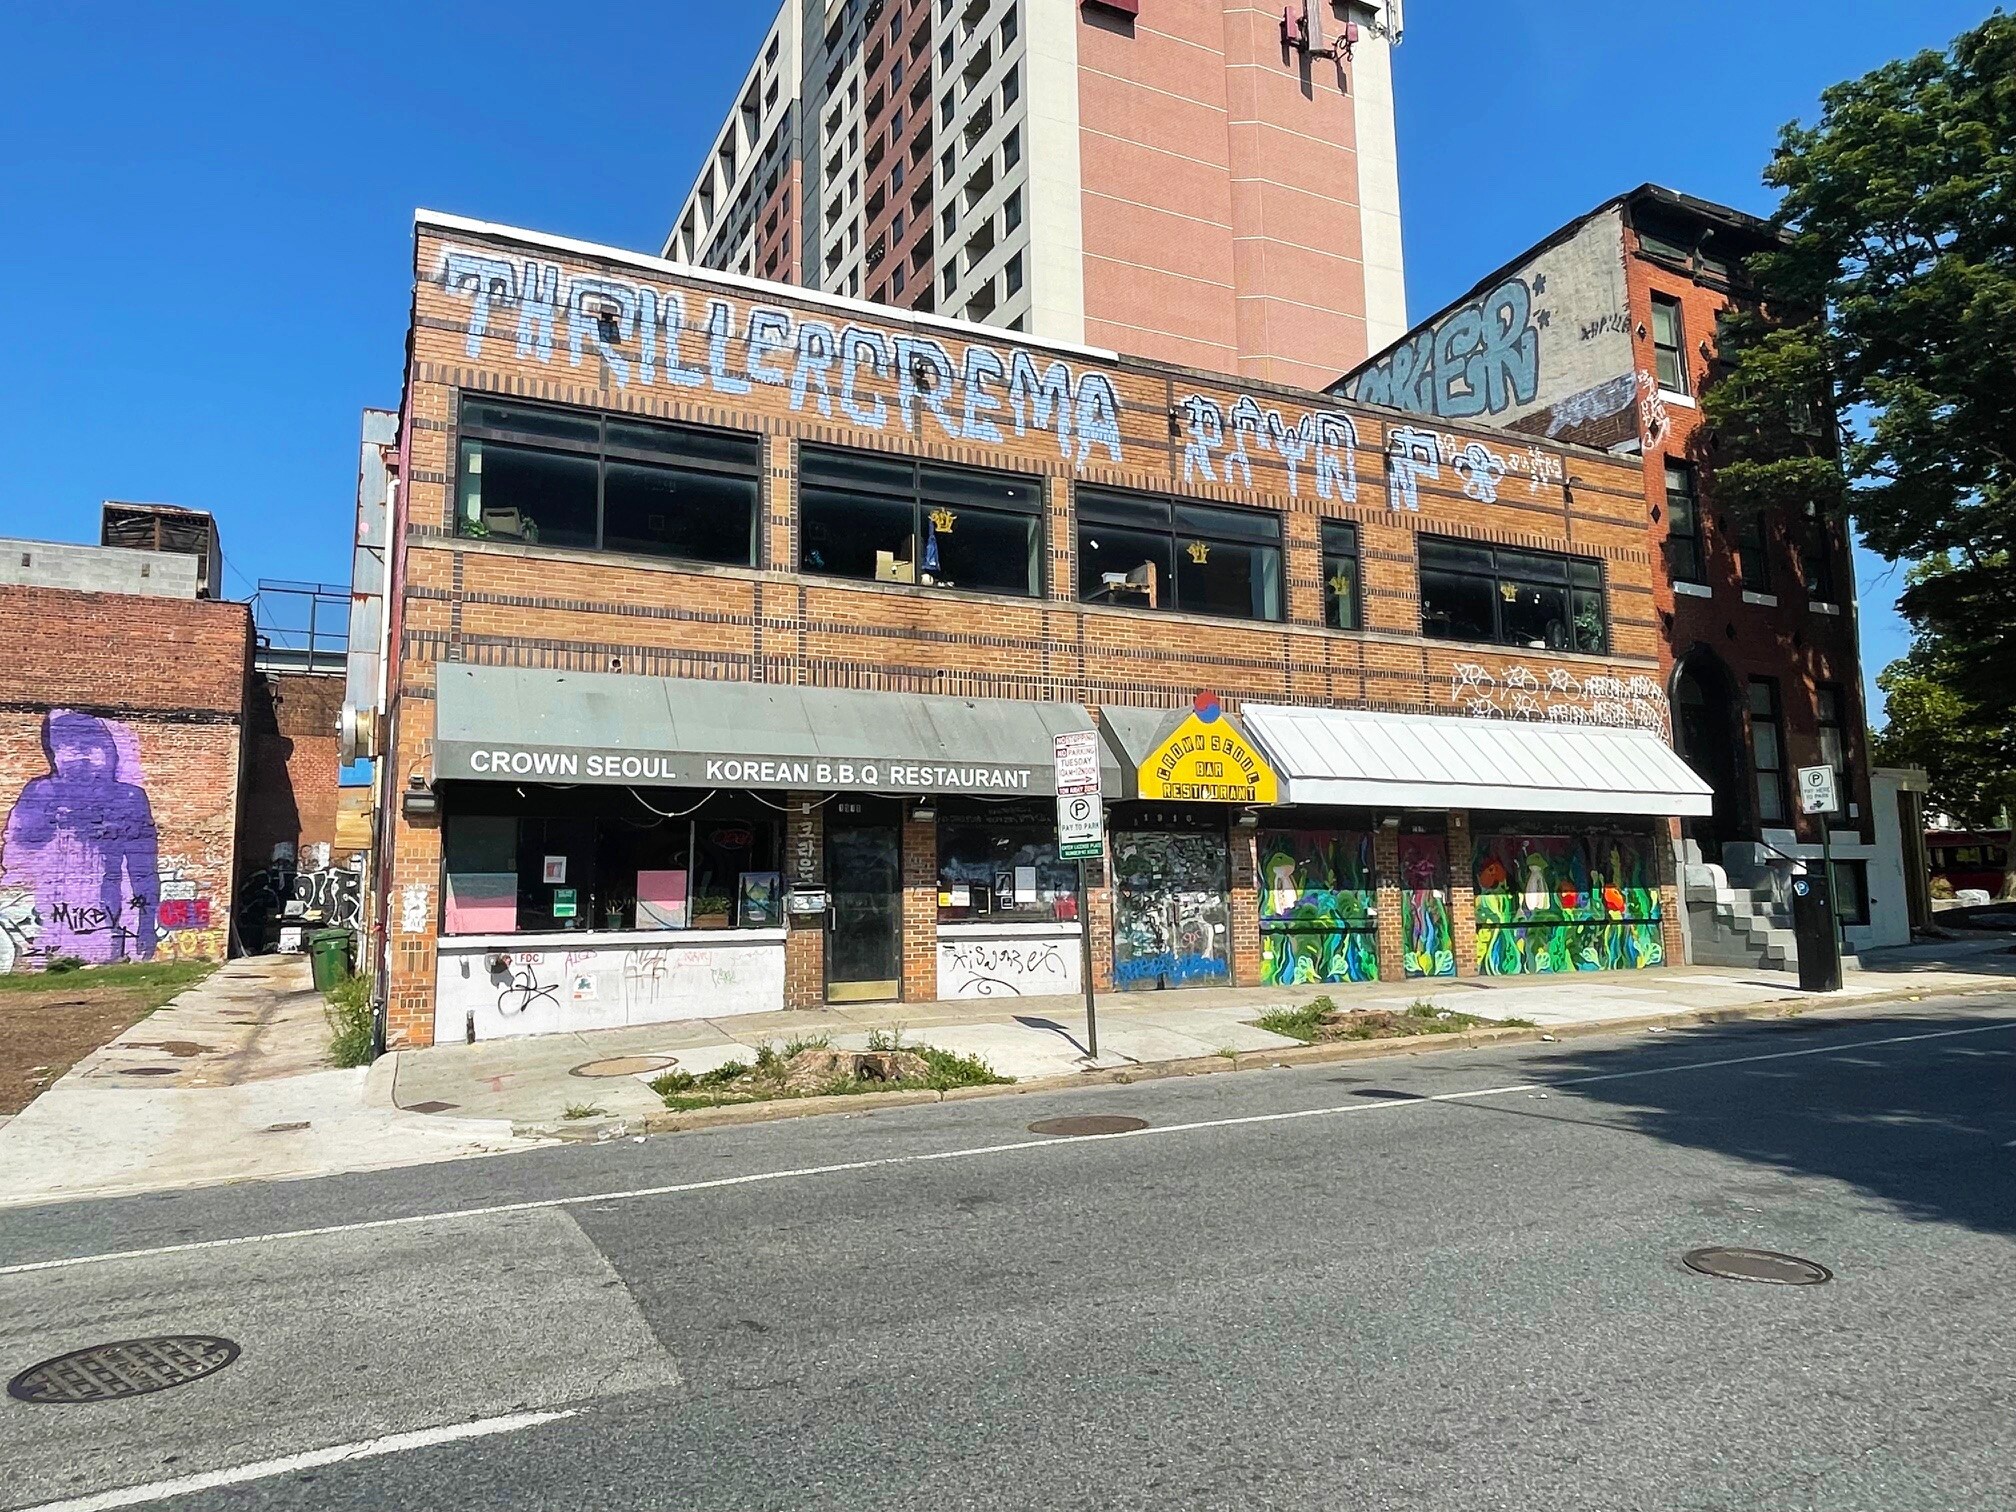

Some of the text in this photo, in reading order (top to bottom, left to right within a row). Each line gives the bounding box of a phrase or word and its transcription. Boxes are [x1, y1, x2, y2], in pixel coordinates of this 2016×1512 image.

[1061, 757, 1092, 767] TUESDAY
[1157, 735, 1259, 784] CROWN SEOUL
[470, 750, 1031, 788] CROWN SEOUL KOREAN B.B.Q RESTAURANT
[1196, 761, 1223, 777] BAR
[1162, 783, 1255, 801] RESTAURANT
[1062, 822, 1099, 832] PAY TO PARK
[520, 953, 539, 962] FDC
